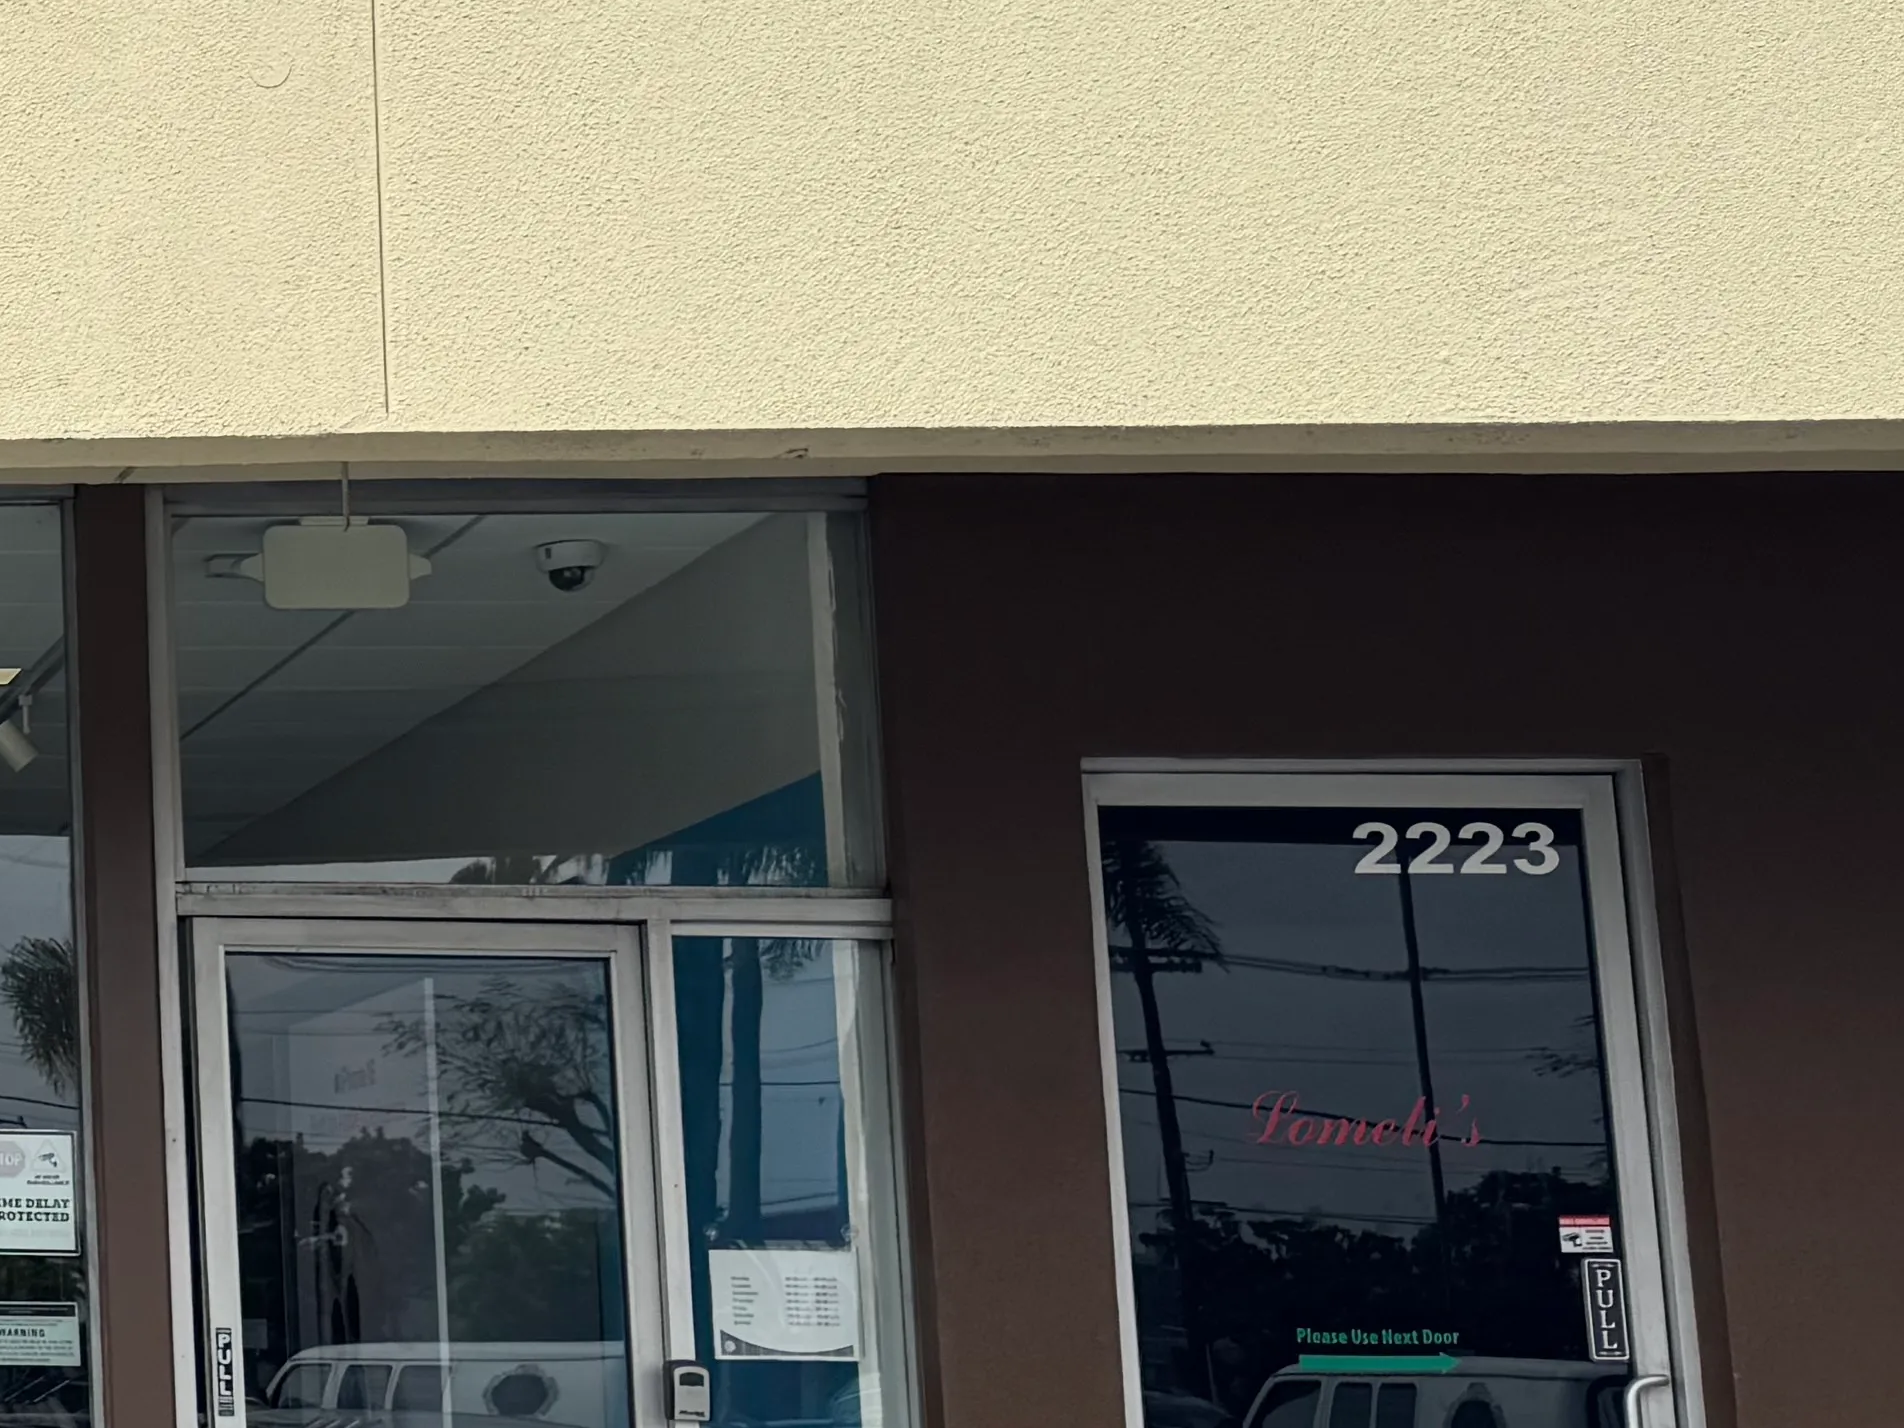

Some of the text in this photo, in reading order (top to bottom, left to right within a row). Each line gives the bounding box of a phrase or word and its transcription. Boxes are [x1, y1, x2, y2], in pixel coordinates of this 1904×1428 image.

[1352, 821, 1560, 875] 2223
[25, 1197, 71, 1209] DELAY
[1296, 1327, 1460, 1345] Please Use Next Door
[1595, 1269, 1618, 1349] PULL
[217, 1333, 232, 1396] PULL
